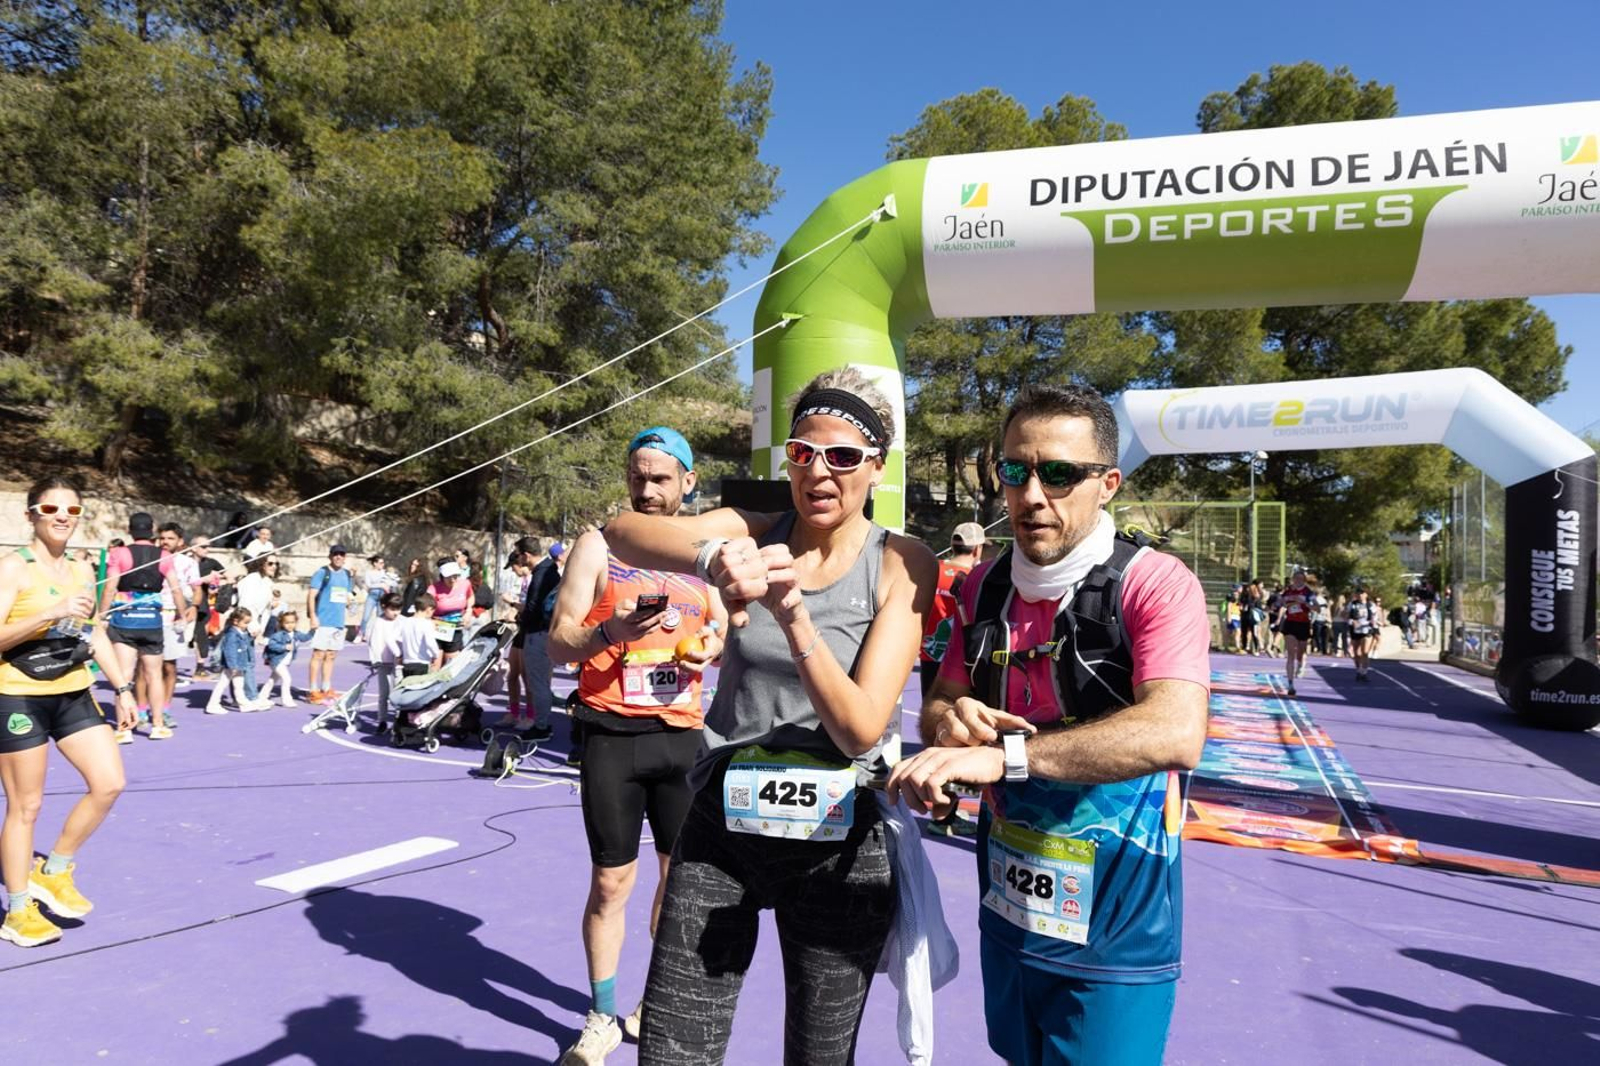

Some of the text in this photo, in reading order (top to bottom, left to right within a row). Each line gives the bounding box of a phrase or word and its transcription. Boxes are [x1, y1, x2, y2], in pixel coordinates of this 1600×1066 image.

[1030, 140, 1507, 206] DIPUTACIÓN DE JAÉN
[1538, 170, 1598, 205] Jaé
[1521, 203, 1600, 218] PARAÍSO INTE
[944, 212, 1004, 242] Jaén
[934, 239, 1016, 252] PARAÍSO INTERIOR
[1172, 392, 1407, 430] TIME2RUN
[1273, 421, 1409, 437] CRONOMETRAJE DEPORTIVO
[1557, 509, 1580, 591] TUS METAS
[1530, 549, 1555, 632] CONSIGUE
[646, 670, 676, 686] 120
[1530, 688, 1600, 704] time2run.es
[759, 780, 817, 807] 425
[1006, 864, 1053, 900] 428
